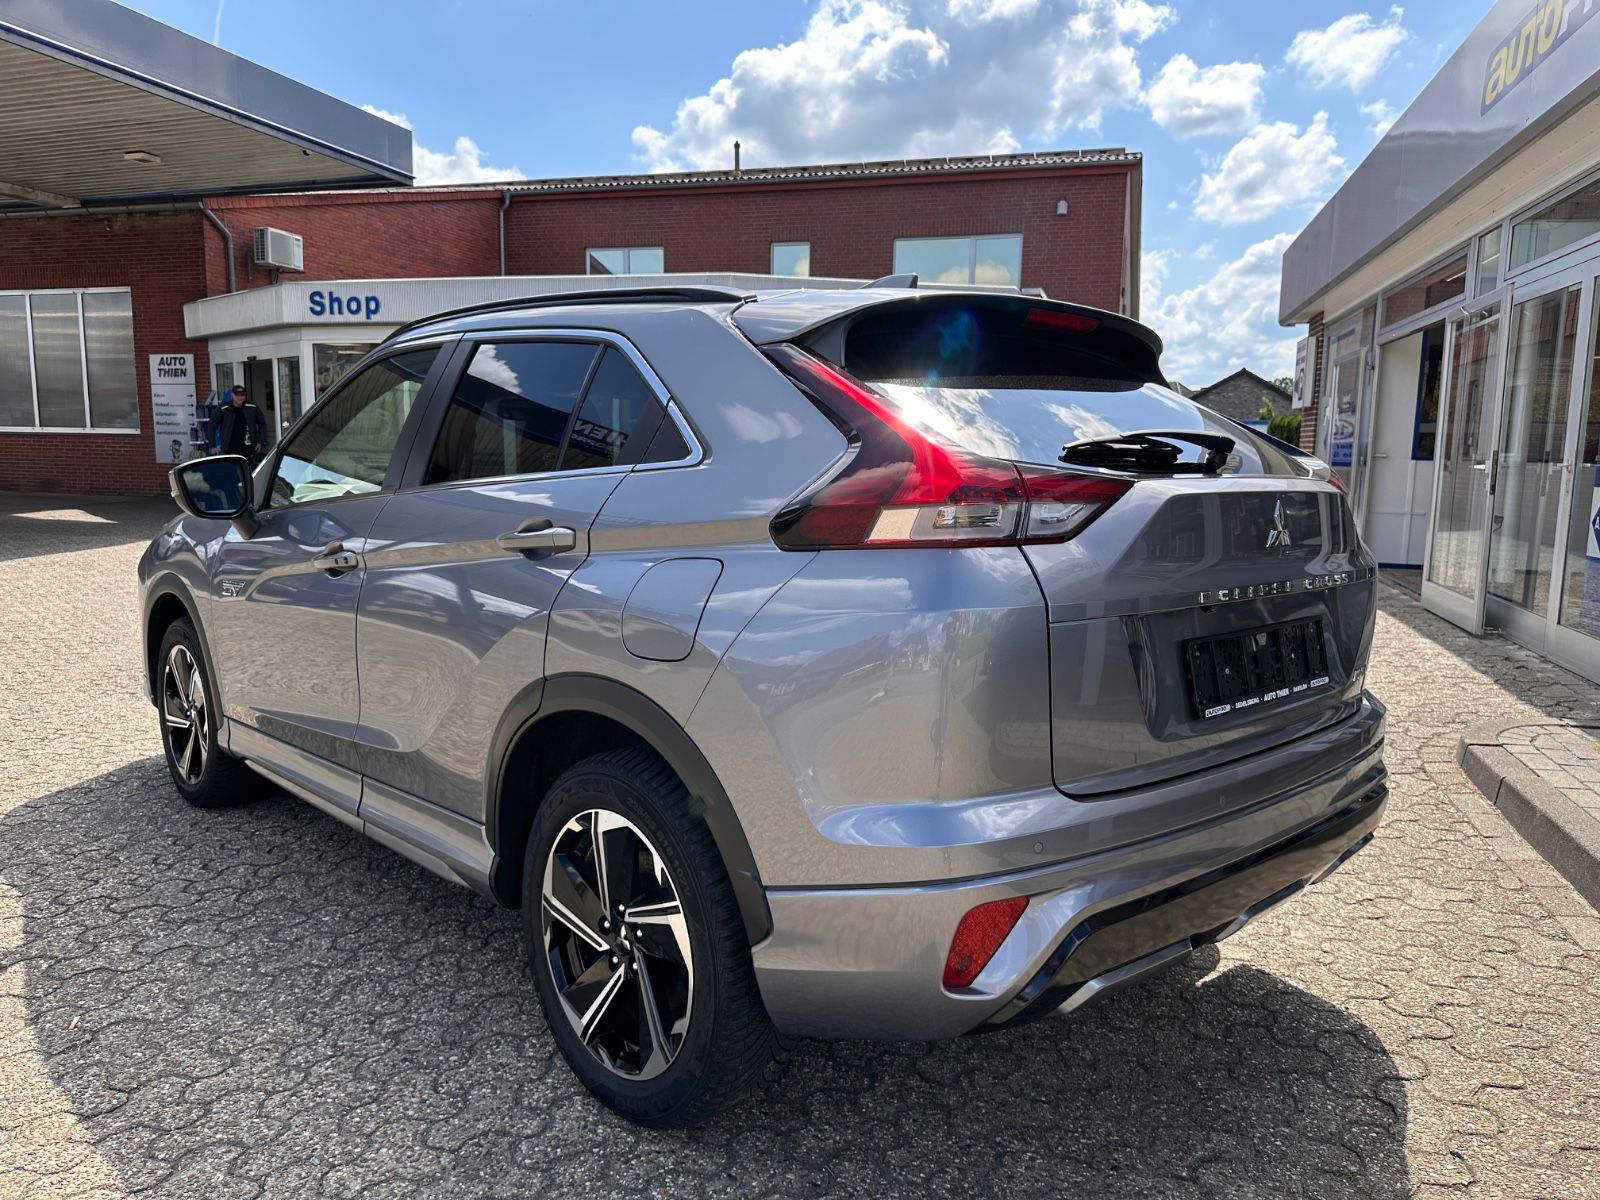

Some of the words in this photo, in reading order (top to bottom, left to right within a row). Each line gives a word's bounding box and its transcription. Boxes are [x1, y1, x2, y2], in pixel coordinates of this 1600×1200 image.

[309, 290, 381, 320] Shop
[158, 356, 186, 367] AUTO
[157, 368, 187, 378] THIEN
